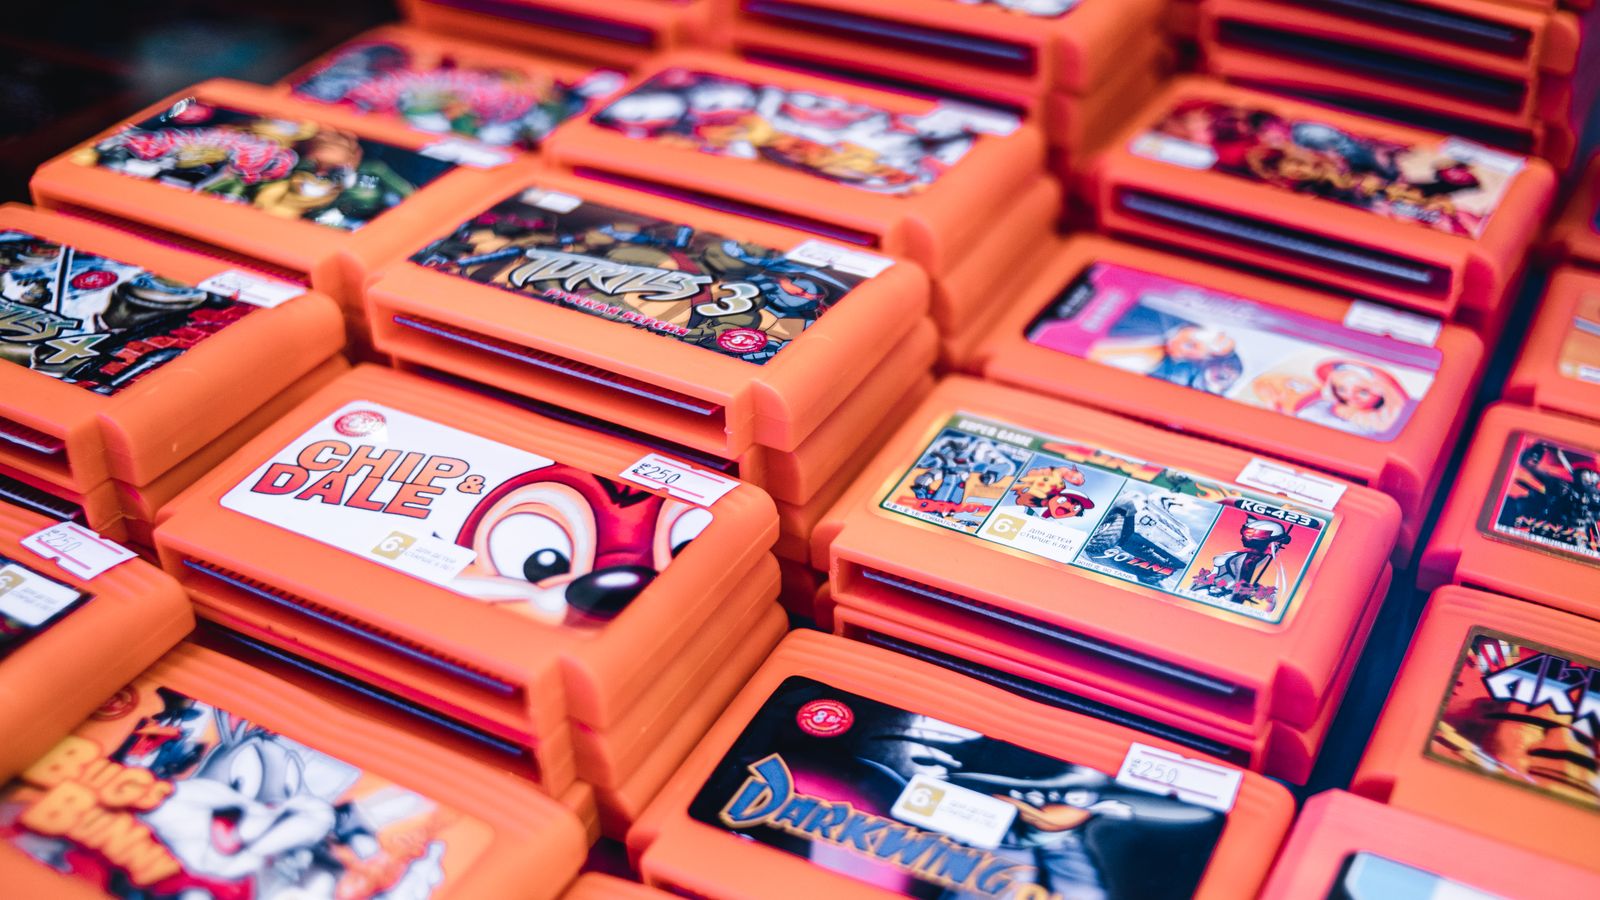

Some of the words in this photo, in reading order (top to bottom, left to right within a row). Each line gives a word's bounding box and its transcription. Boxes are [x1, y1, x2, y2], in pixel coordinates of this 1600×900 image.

[508, 247, 713, 302] TURTLES
[695, 282, 760, 318] 3
[543, 288, 622, 315] РУССКАЯ
[621, 311, 692, 337] ВЕРСИЯ
[43, 333, 112, 364] 4
[957, 419, 998, 437] SUPER
[997, 429, 1034, 447] GAME
[250, 462, 447, 520] DALE
[296, 440, 471, 487] CHIP
[456, 474, 486, 495] &
[1240, 499, 1312, 527] KG-423
[1092, 545, 1130, 562] 90
[719, 752, 1039, 897] DARKWING
